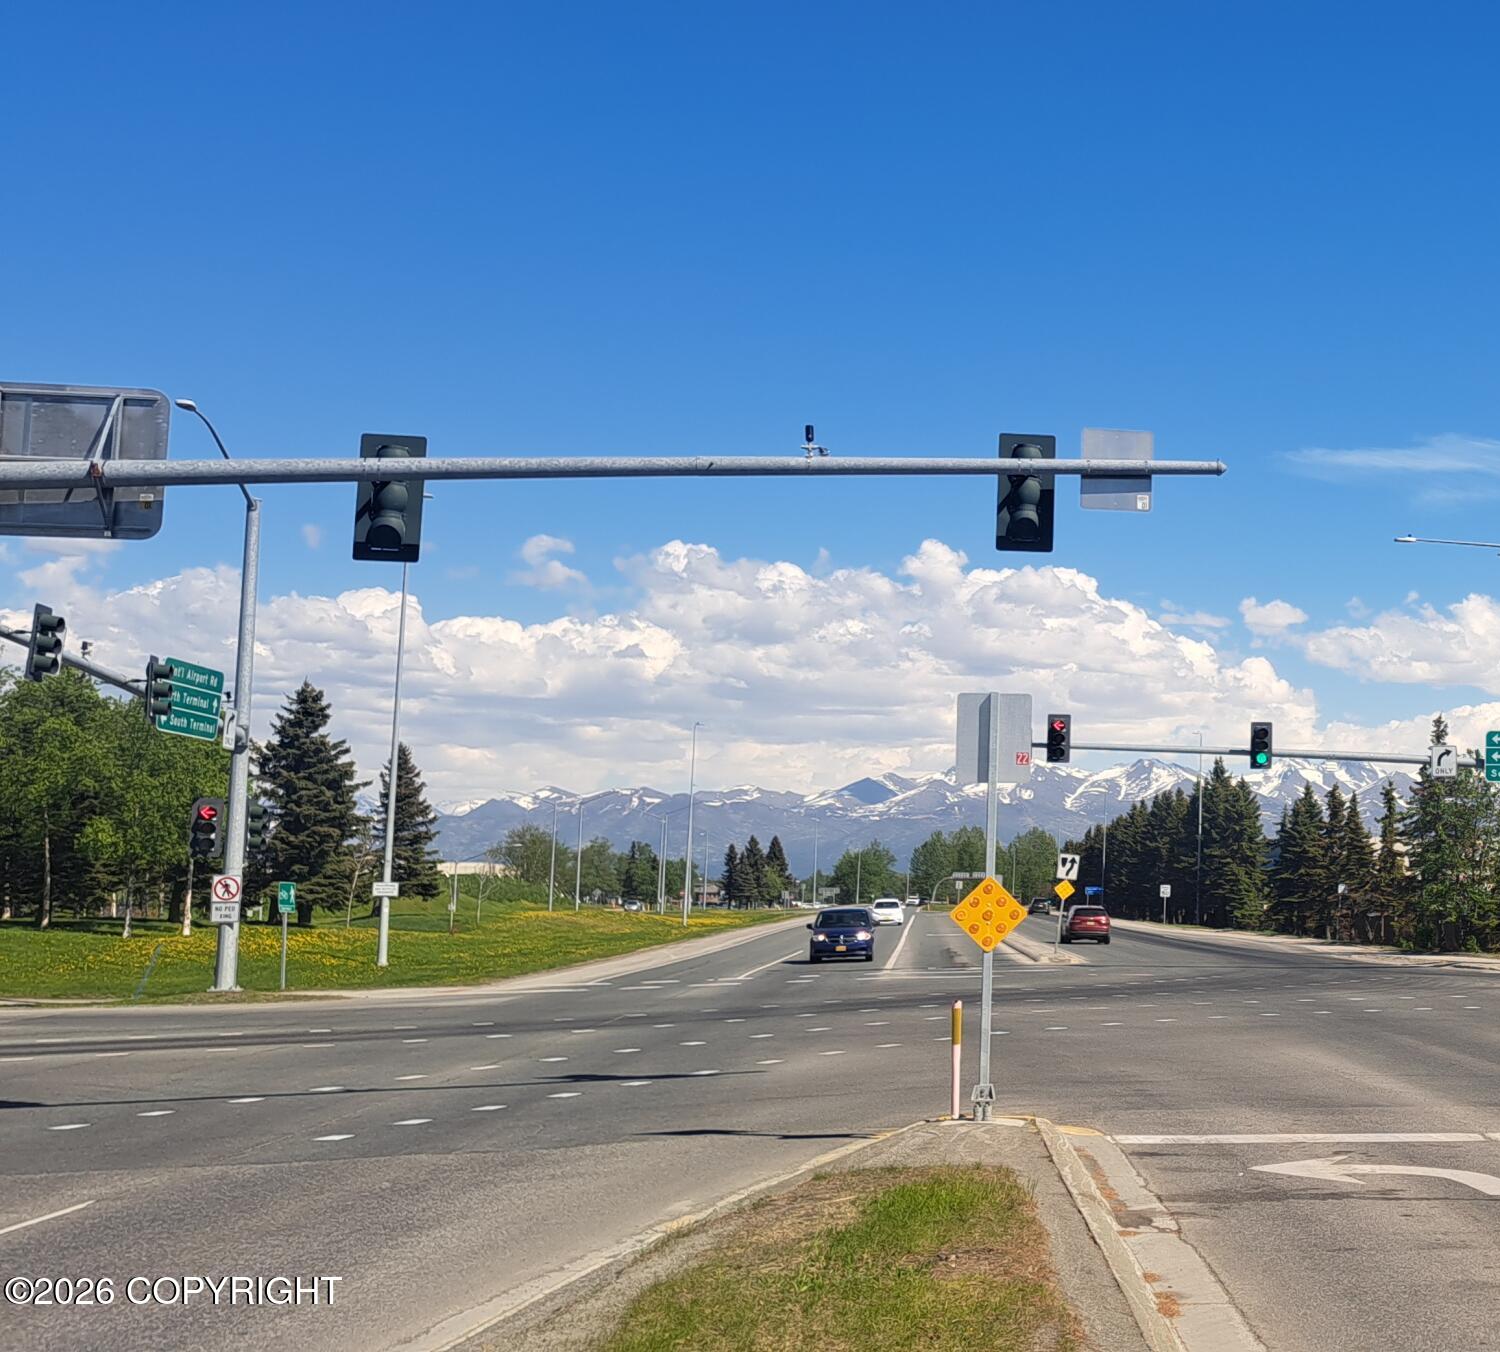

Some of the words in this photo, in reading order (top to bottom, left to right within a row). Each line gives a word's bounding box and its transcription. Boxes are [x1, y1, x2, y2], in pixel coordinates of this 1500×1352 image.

[185, 669, 209, 685] Airport
[209, 676, 218, 687] Rd
[183, 692, 210, 709] Terminal
[169, 713, 188, 728] South
[190, 718, 216, 734] Terminal
[1017, 752, 1029, 765] 22
